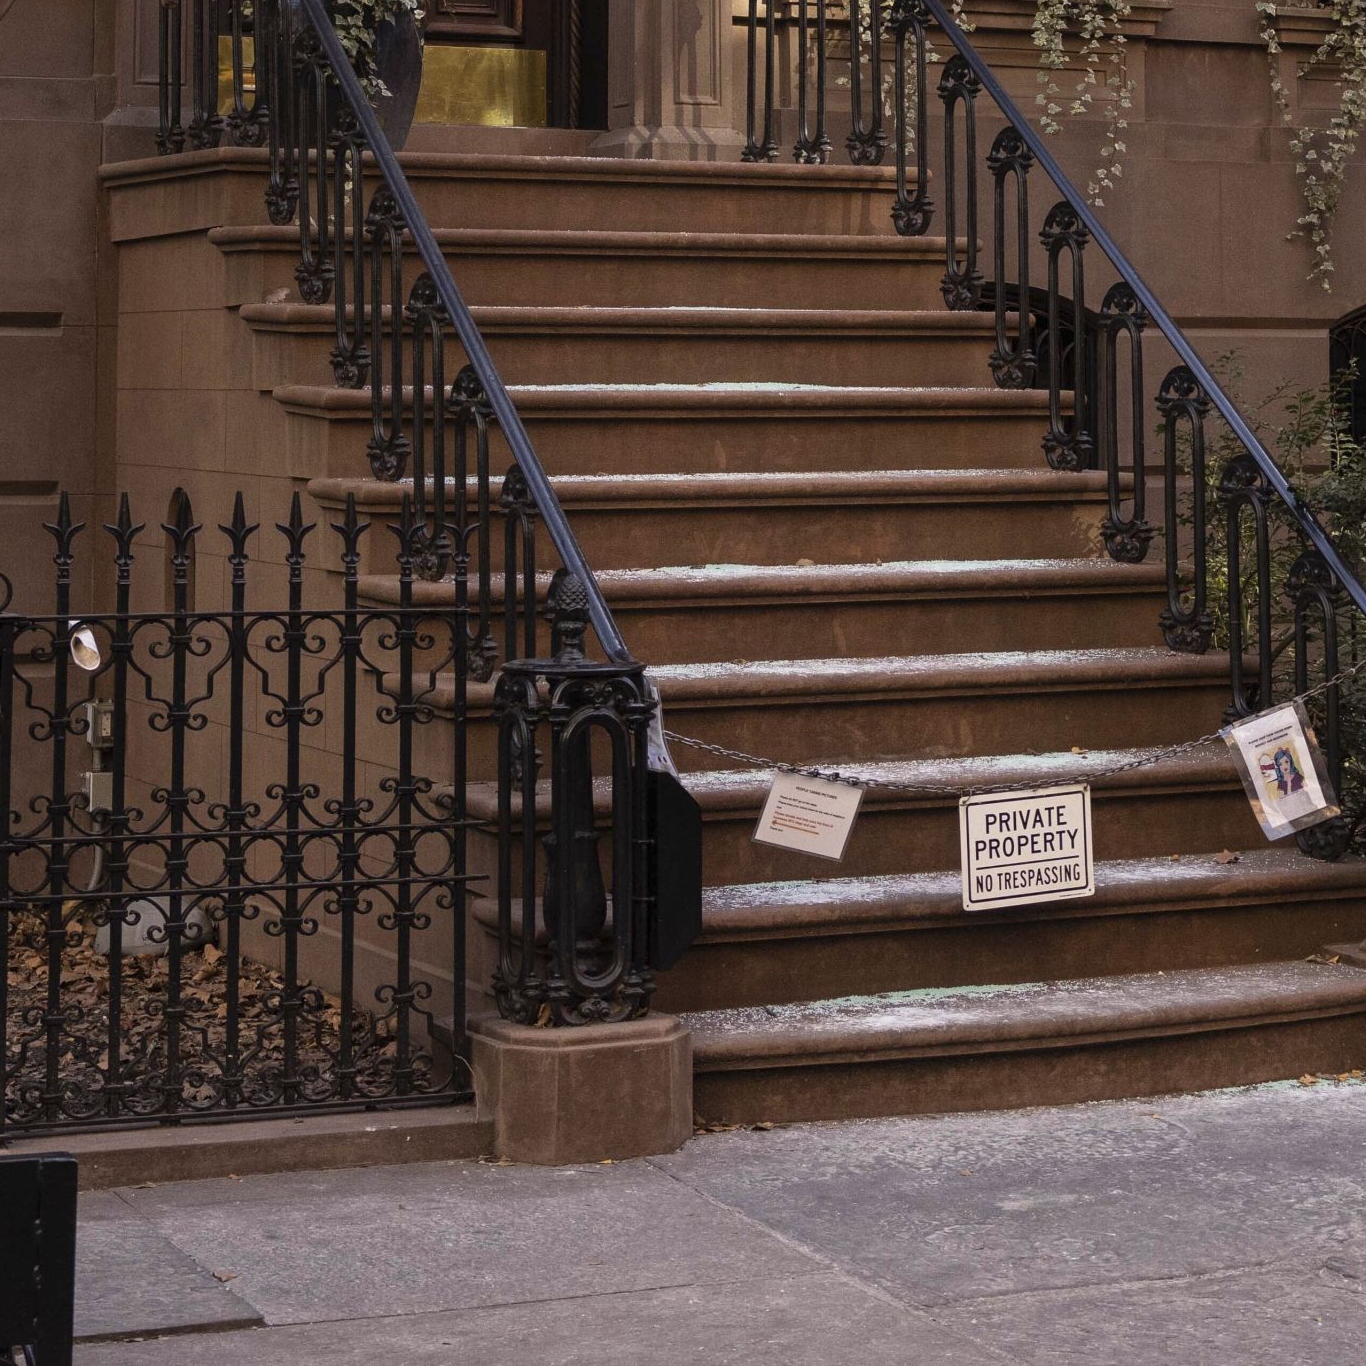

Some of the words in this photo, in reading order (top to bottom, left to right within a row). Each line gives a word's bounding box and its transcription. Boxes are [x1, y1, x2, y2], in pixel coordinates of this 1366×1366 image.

[985, 805, 1067, 834] PRIVATE
[975, 828, 1078, 861] PROPERTY
[976, 874, 993, 893] NO
[996, 863, 1081, 891] TRESPASSING
